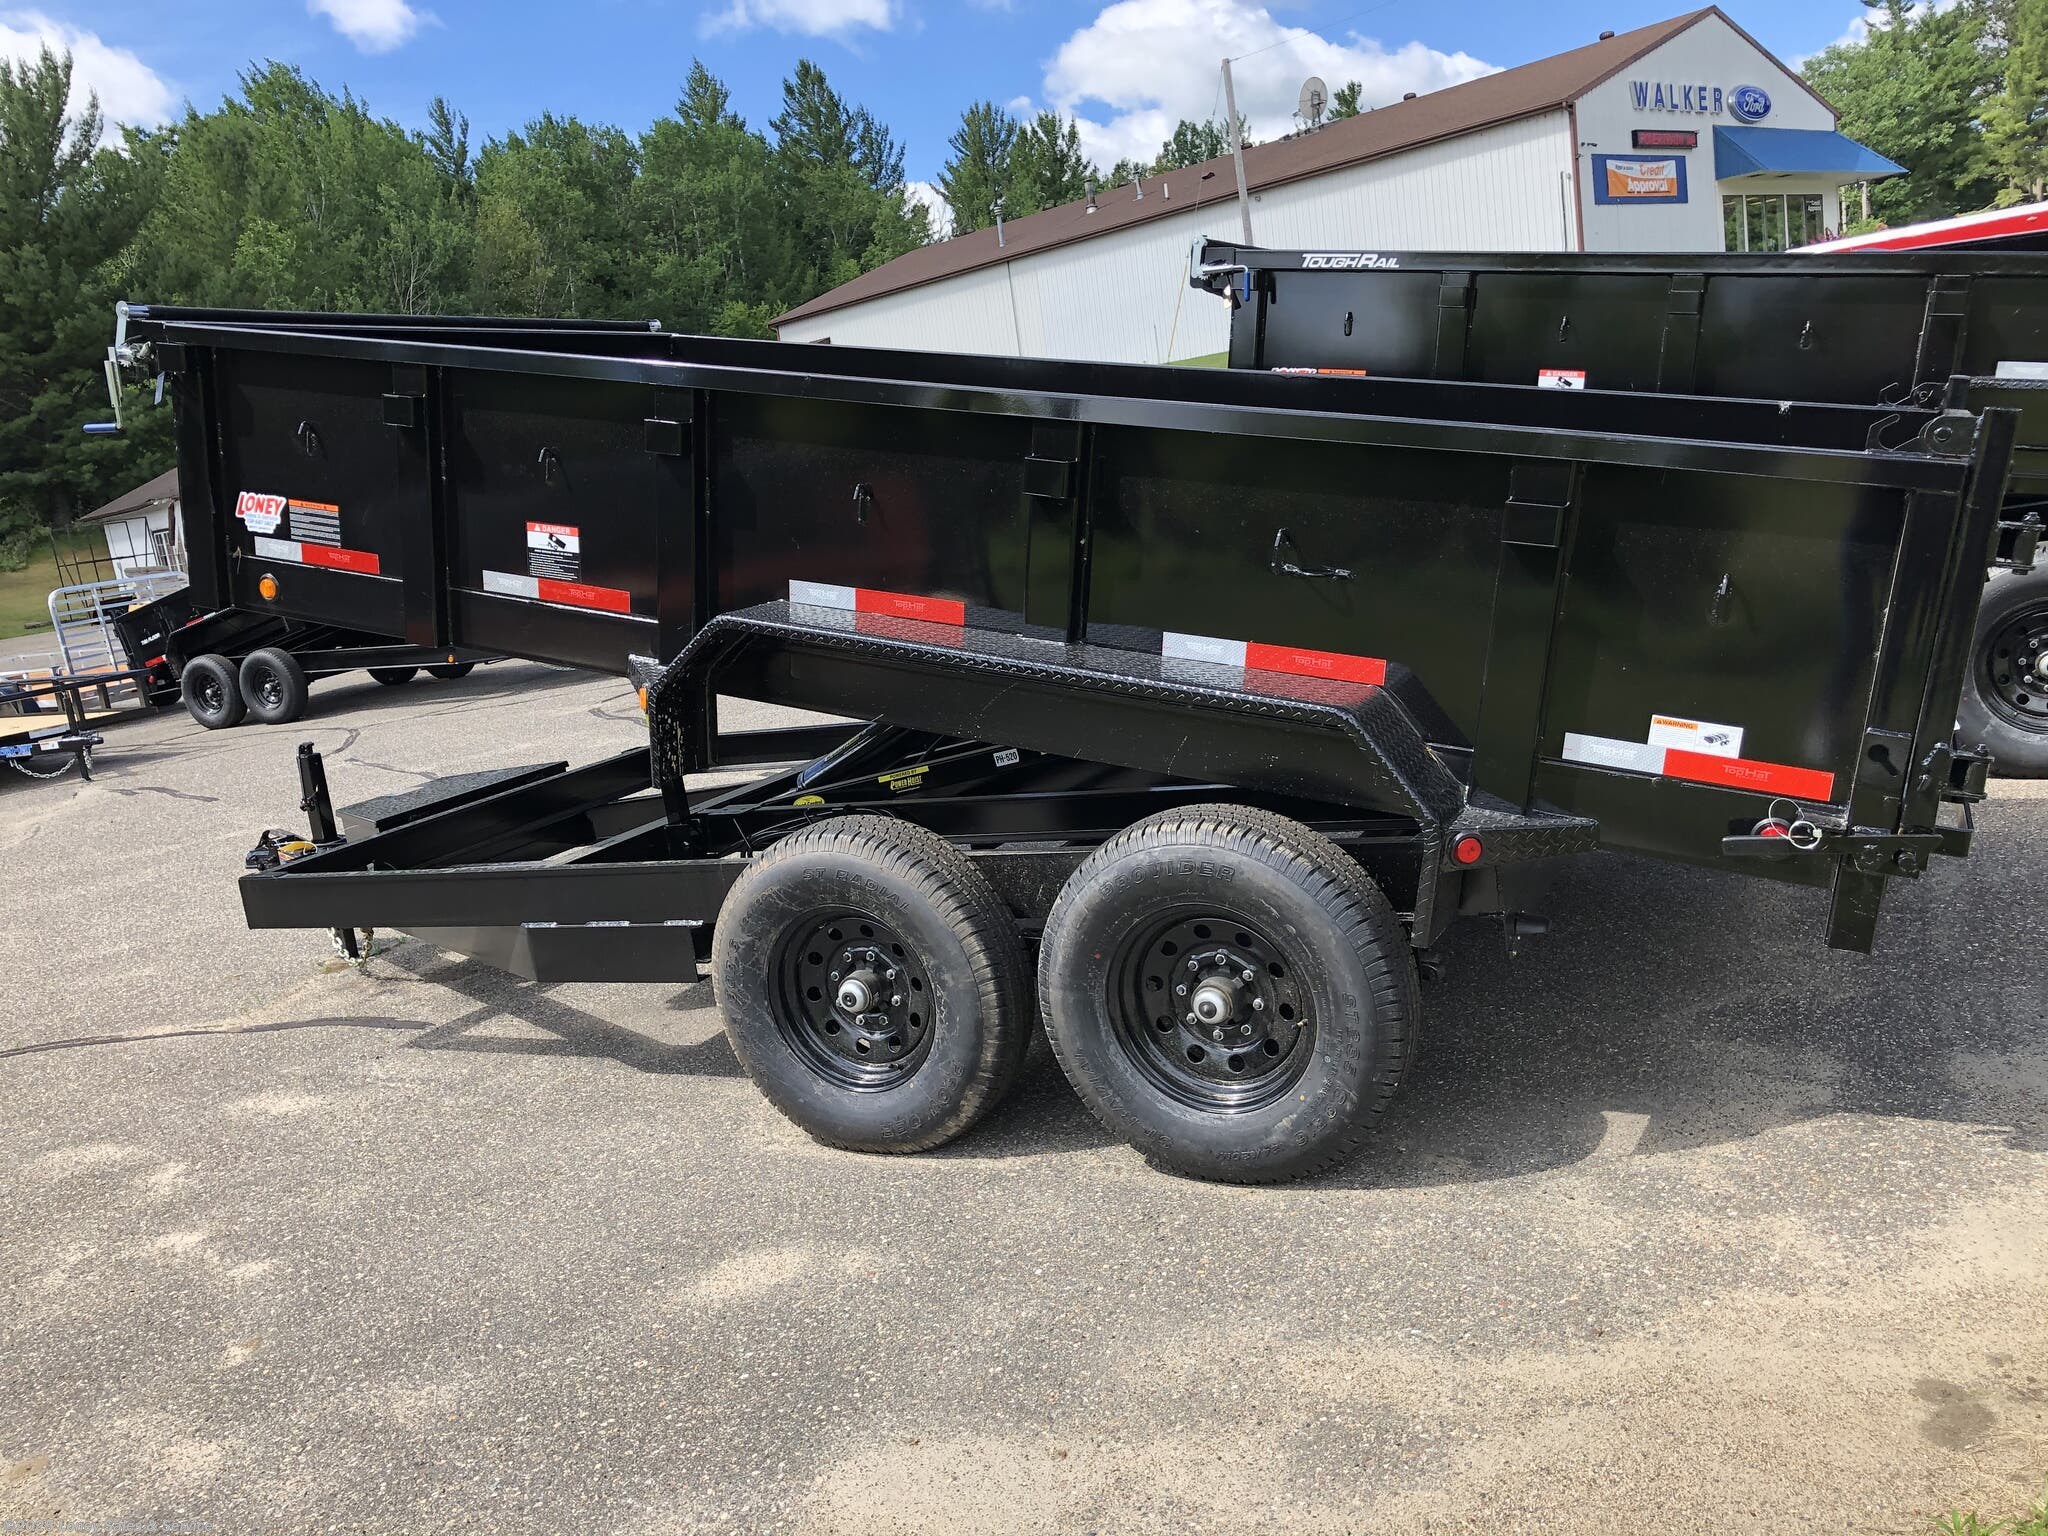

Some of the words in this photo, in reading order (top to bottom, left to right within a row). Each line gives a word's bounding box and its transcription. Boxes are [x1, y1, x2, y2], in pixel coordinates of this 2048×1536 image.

[1629, 81, 1723, 114] WALKER
[1639, 164, 1665, 177] Credit
[1627, 178, 1669, 194] Approval
[237, 494, 284, 516] LONEY
[542, 524, 571, 534] DANGER
[1662, 719, 1694, 729] WARNING
[995, 751, 1018, 764] PH-520
[1099, 858, 1237, 902] PROVIDER
[802, 866, 827, 880] ST
[835, 868, 913, 914] RADIAL
